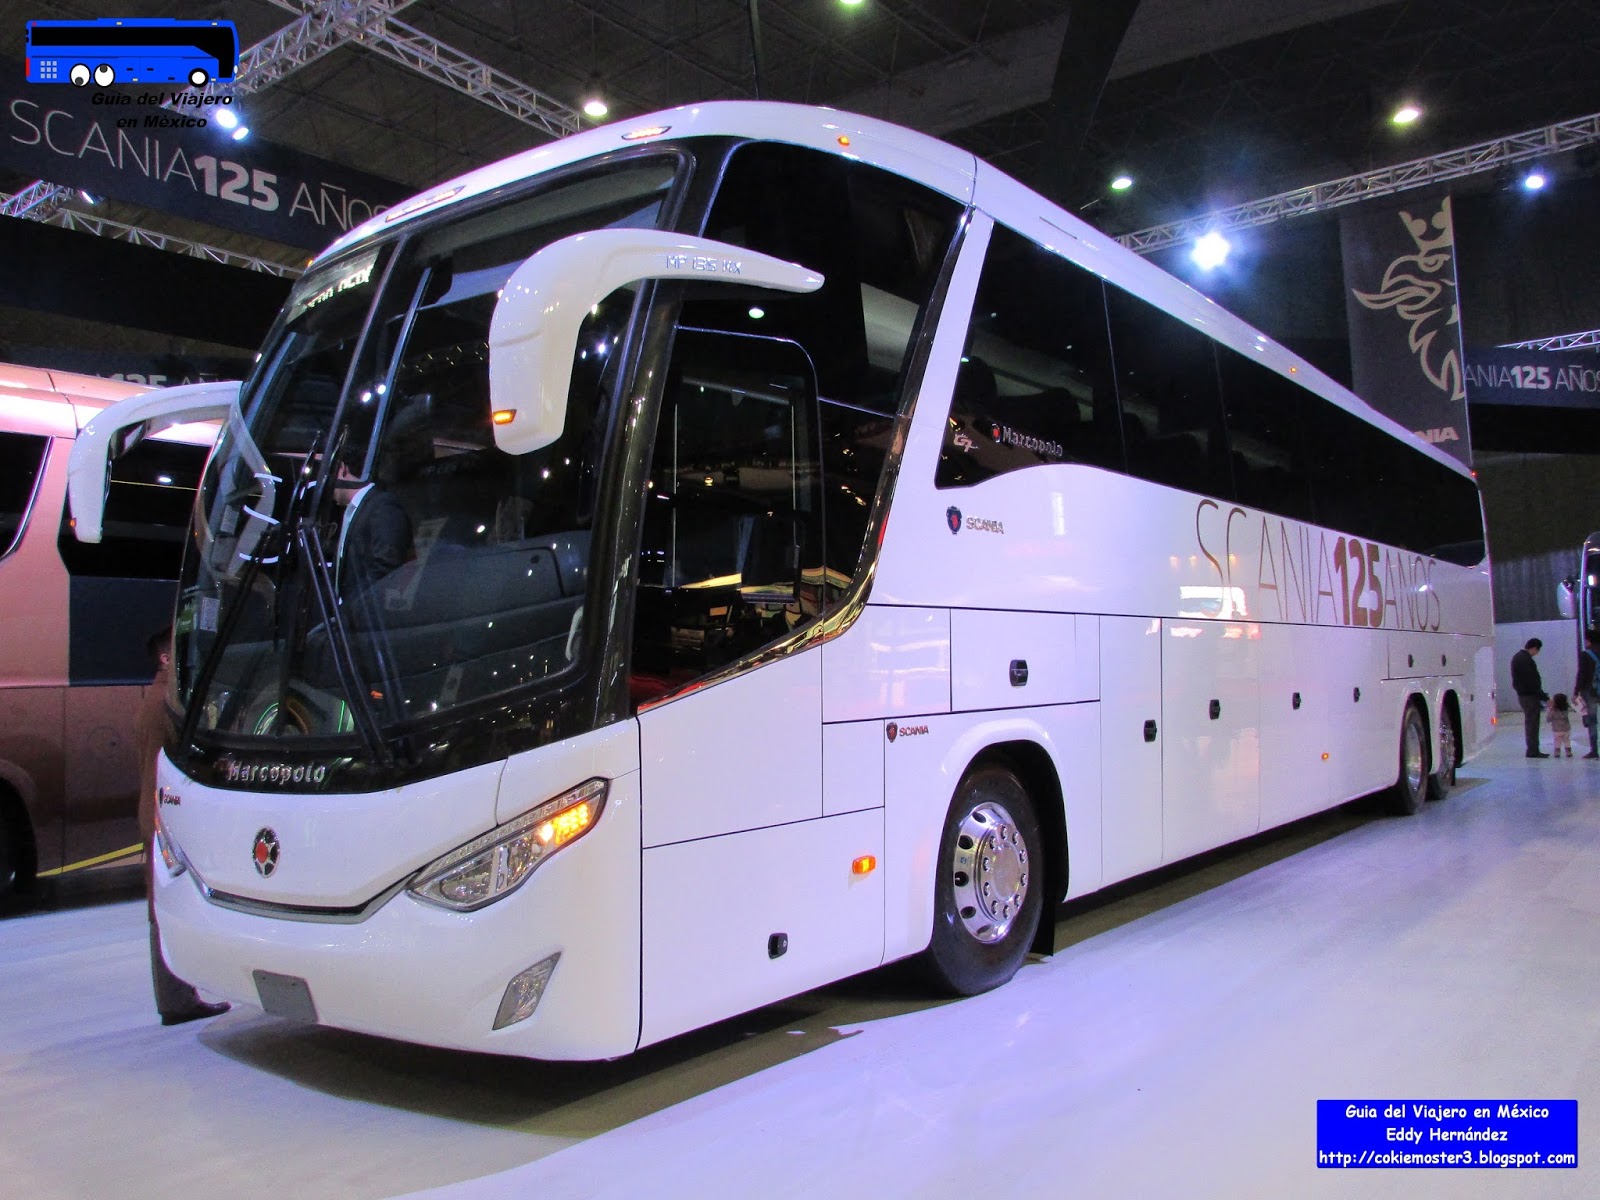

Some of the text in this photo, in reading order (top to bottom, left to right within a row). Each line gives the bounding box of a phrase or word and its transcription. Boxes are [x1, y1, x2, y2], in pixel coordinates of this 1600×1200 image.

[288, 181, 391, 232] AÑO
[1002, 425, 1063, 457] Marcopolo
[966, 516, 1004, 534] SCANIA
[899, 725, 929, 737] SCANIA
[227, 761, 326, 784] Marcopolo
